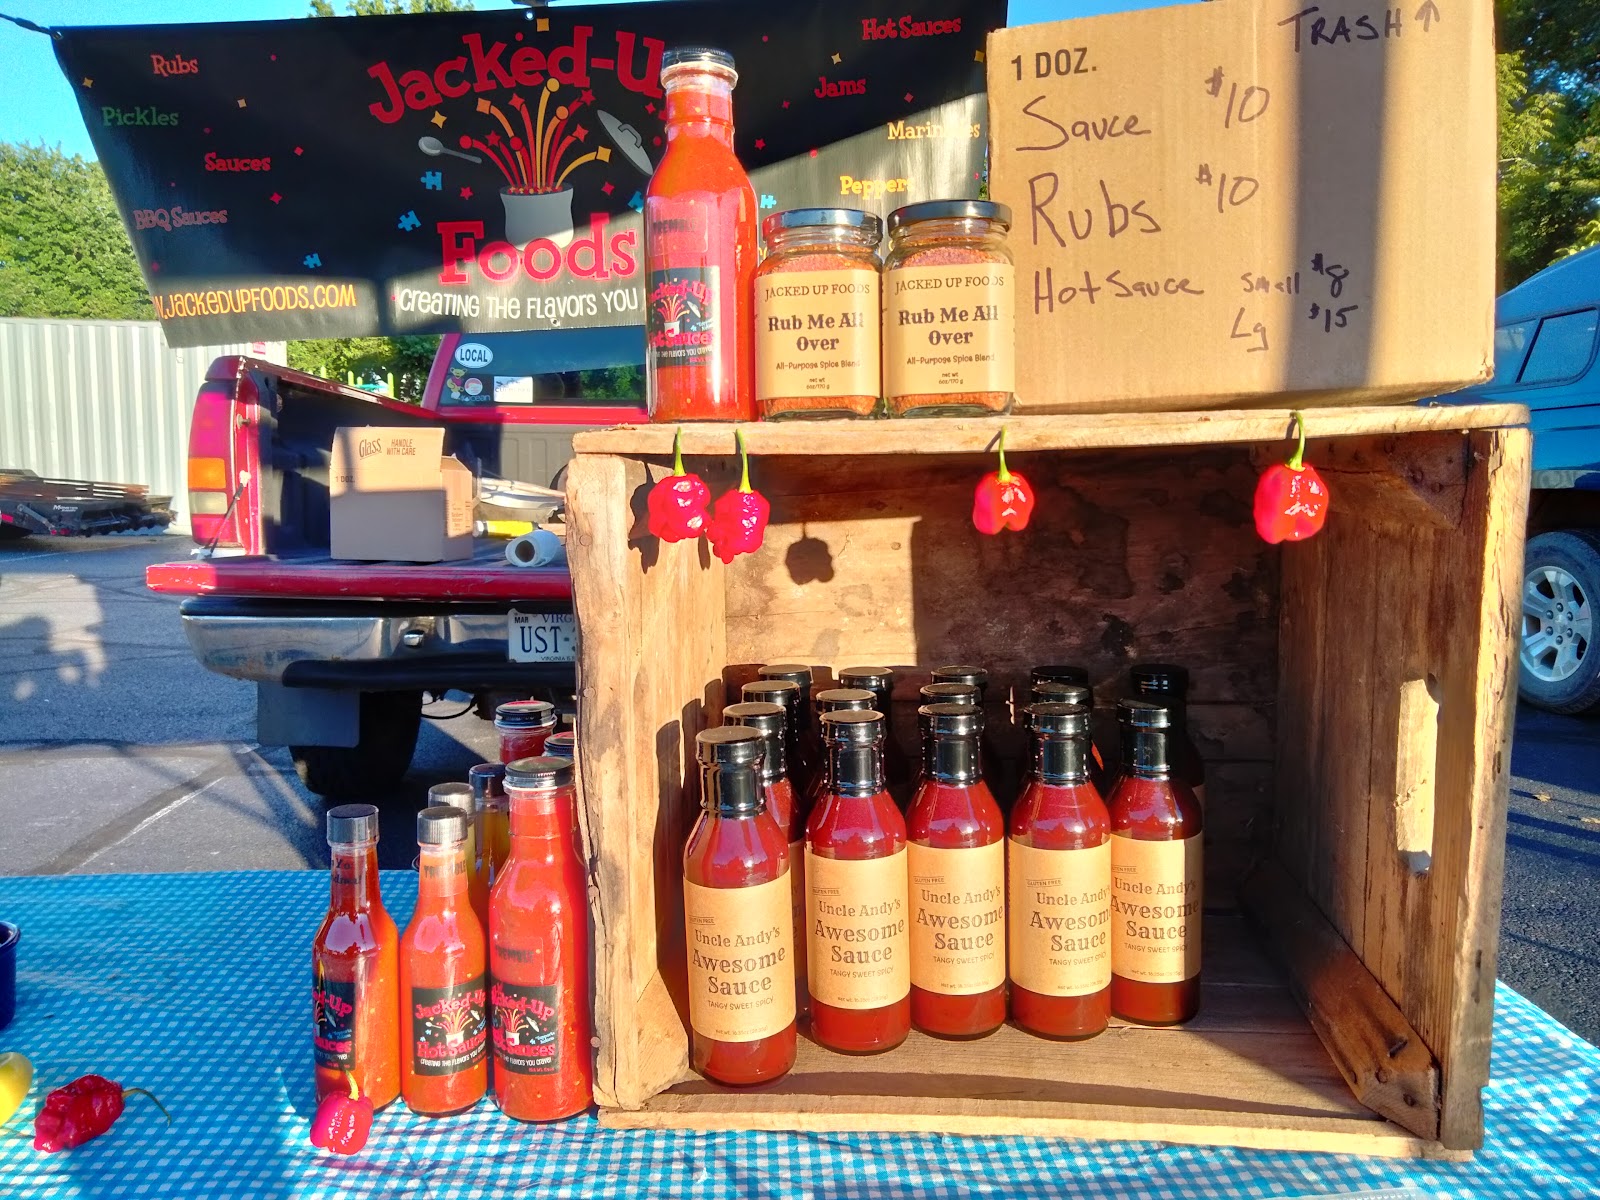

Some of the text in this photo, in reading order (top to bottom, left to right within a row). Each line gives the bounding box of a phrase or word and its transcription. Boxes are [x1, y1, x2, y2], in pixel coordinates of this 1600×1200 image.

[861, 15, 962, 40] Hot Sauces
[1278, 7, 1402, 52] TRASH
[151, 54, 199, 77] Rubs
[1011, 47, 1097, 80] 1 DOZ.
[367, 26, 666, 124] Jacked-U
[814, 76, 867, 98] Jams
[102, 106, 179, 127] Pickles
[1016, 66, 1270, 151] Sauce $10
[887, 121, 981, 140] Marines
[204, 152, 271, 172] Sauces
[1028, 164, 1259, 247] Rubs $10
[133, 206, 228, 231] BBQ Sauces
[436, 212, 638, 286] Foods
[765, 284, 870, 302] JACKED UP FOODS
[895, 276, 1004, 295] JACKED UP FOODS
[1034, 267, 1102, 315] Hot
[1106, 271, 1205, 297] Sauce
[601, 287, 638, 312] YOU
[768, 312, 864, 332] Rub Me All
[898, 305, 998, 326] Rub Me All
[1308, 302, 1359, 333] $15
[796, 336, 840, 351] Over
[928, 330, 974, 345] Over
[460, 348, 488, 362] LOCAL
[820, 360, 839, 370] Spice
[906, 356, 951, 365] All-Purpose
[952, 354, 973, 364] Spice
[359, 438, 382, 458] Glass
[387, 447, 416, 456] WITH CARE
[391, 438, 413, 448] HANDLE
[541, 614, 575, 624] VIRG
[520, 626, 575, 653] UST-
[921, 886, 1001, 904] Uncle Andy's
[1114, 877, 1196, 895] Uncle Andy's
[819, 899, 901, 917] Uncle Andy's
[1036, 892, 1077, 906] Uncle
[1110, 895, 1199, 919] Awesome
[916, 906, 1003, 929] Awesome
[1029, 908, 1111, 931] Awesom
[694, 926, 780, 947] Uncle Andy's
[814, 918, 905, 943] Awesome
[1126, 920, 1187, 940] Sauce
[934, 932, 994, 951] Sauce
[1050, 931, 1106, 952] Sauce
[1124, 943, 1146, 953] TANGY
[692, 946, 786, 974] Awesome
[831, 945, 892, 964] Sauce
[933, 955, 955, 965] TANGY
[956, 956, 978, 965] SWEET
[1049, 951, 1107, 966] TANGY SWEET SPIC
[829, 966, 894, 978] TANGY SWEET SPICY
[707, 975, 772, 996] Sauce
[707, 995, 774, 1011] TANGY SWEET SPICY
[417, 1041, 446, 1059] Hot
